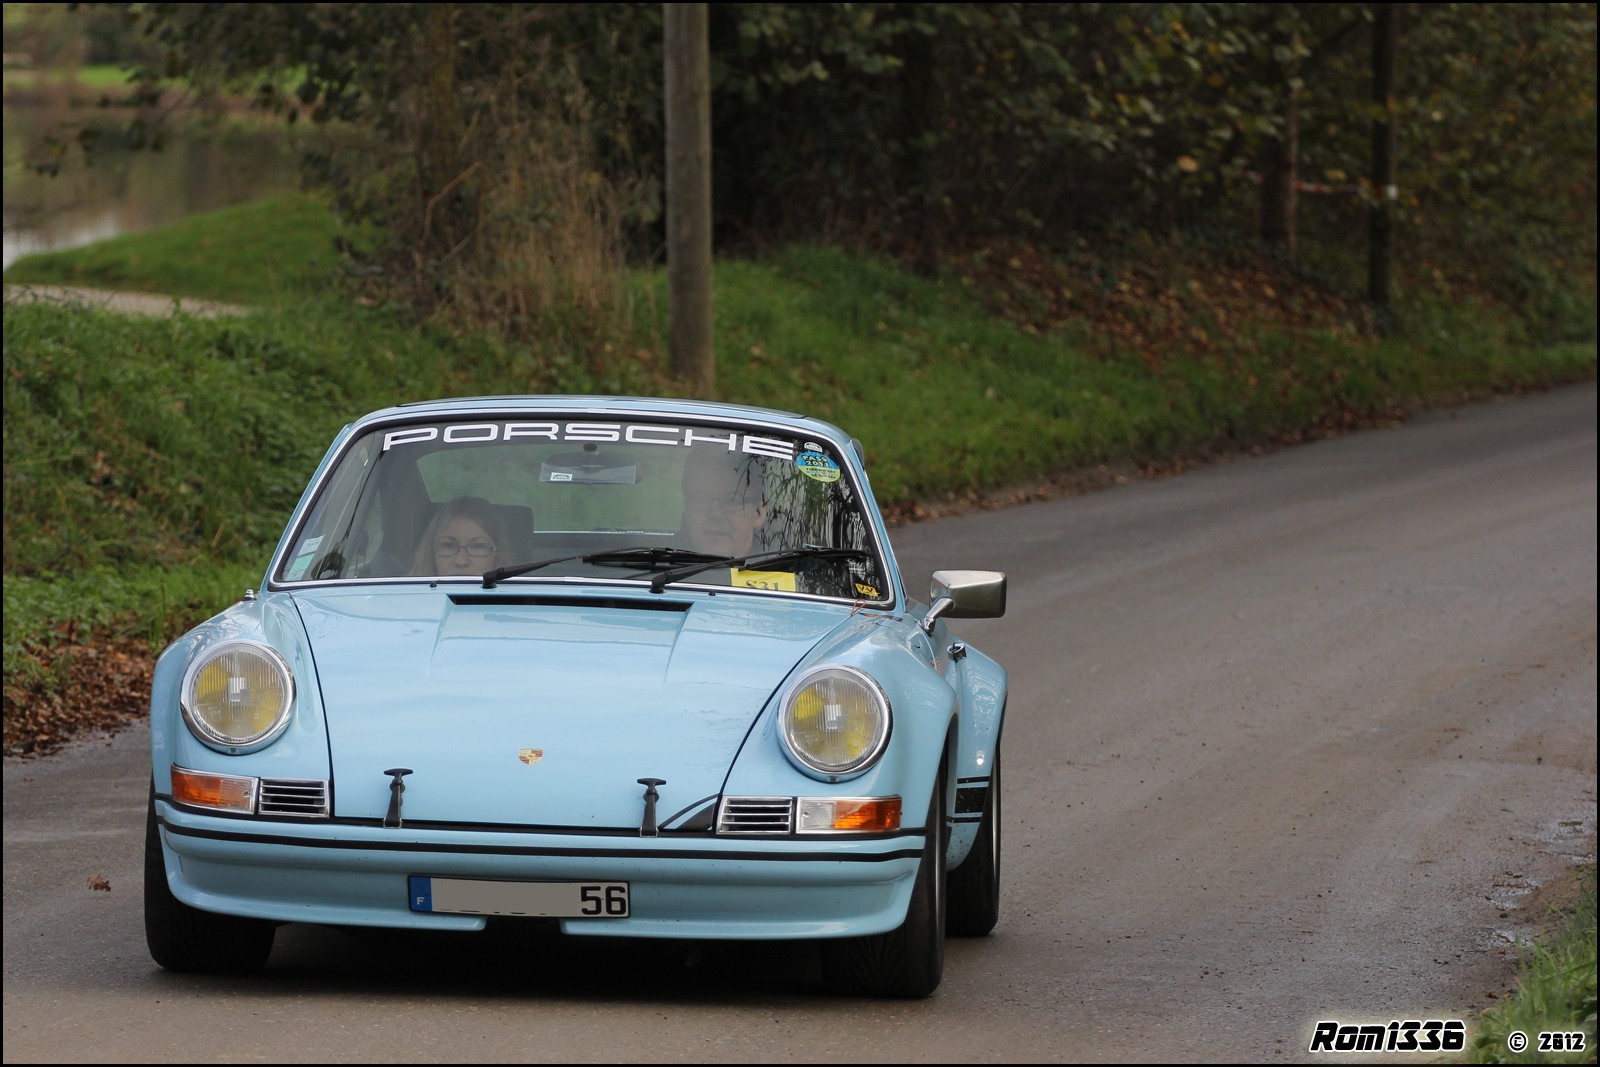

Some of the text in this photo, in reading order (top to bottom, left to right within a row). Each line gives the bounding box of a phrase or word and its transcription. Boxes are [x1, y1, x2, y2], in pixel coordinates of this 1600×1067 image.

[382, 422, 794, 461] PORSCHE
[416, 896, 425, 905] F
[580, 886, 627, 916] 56
